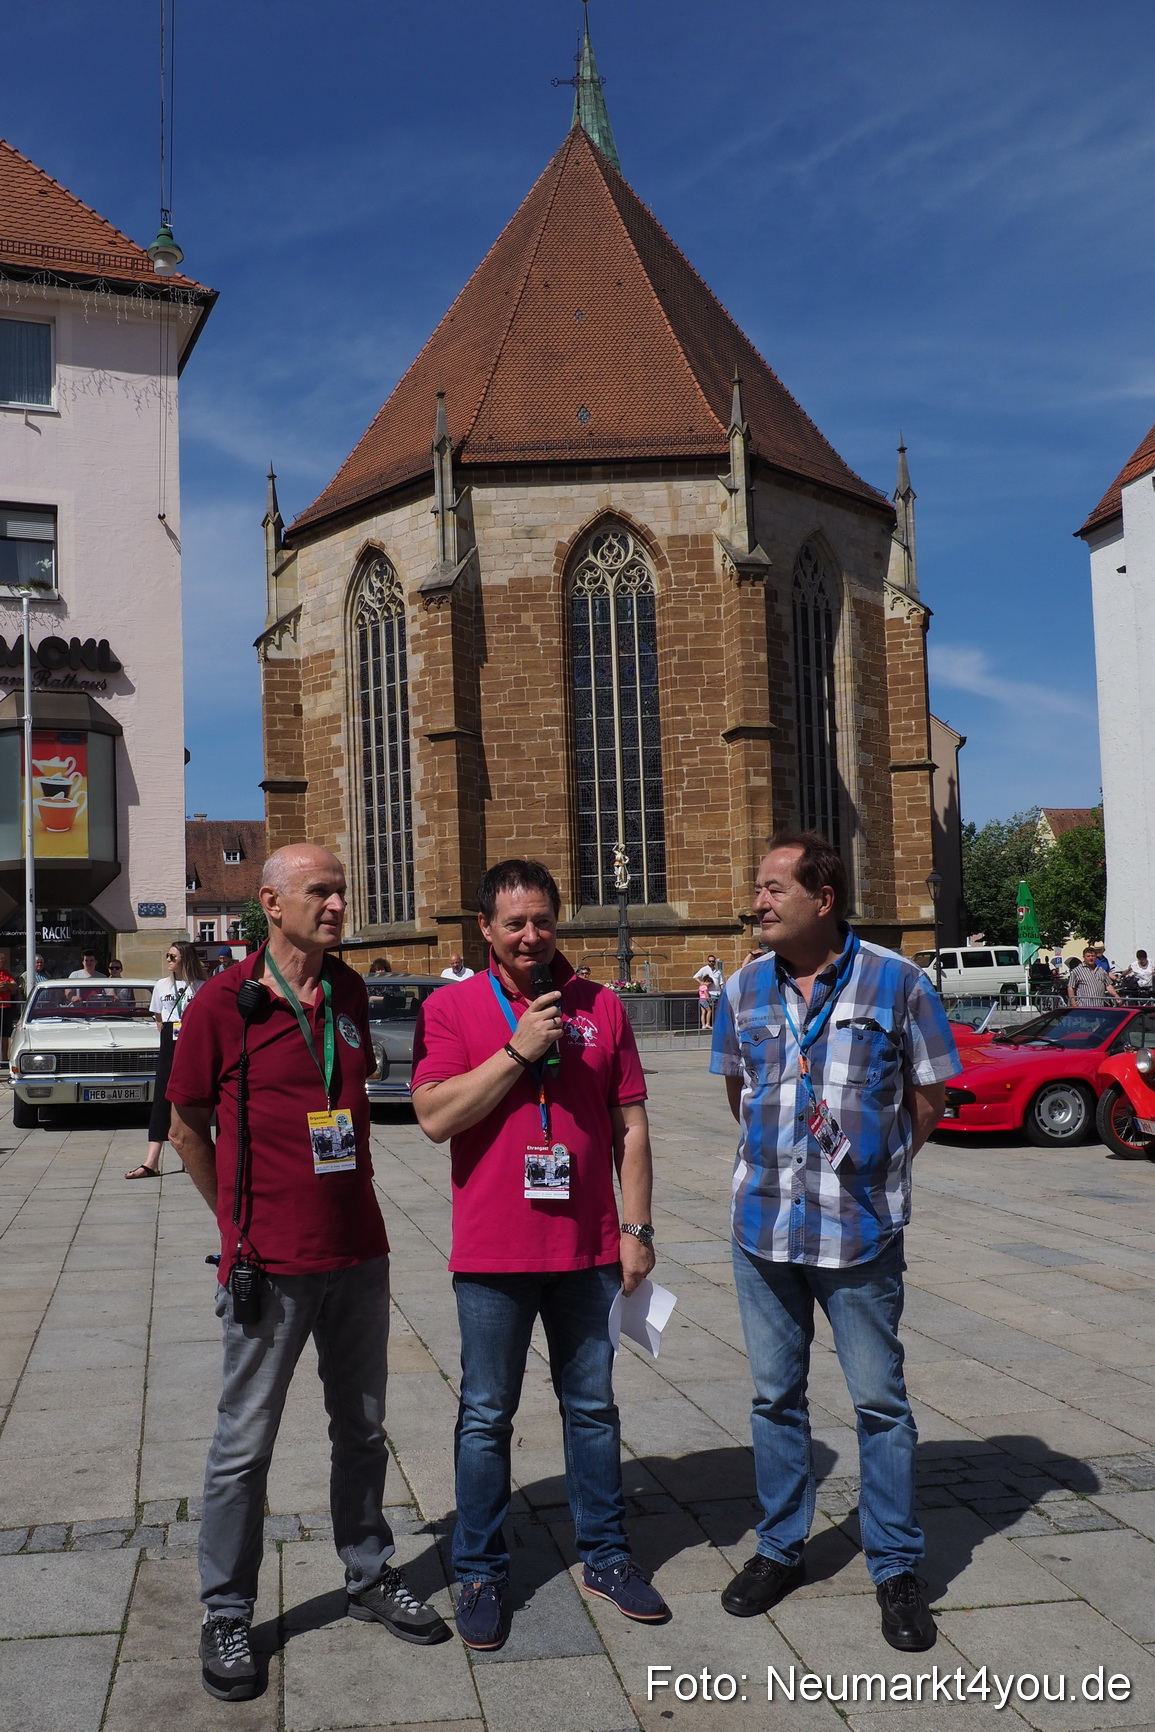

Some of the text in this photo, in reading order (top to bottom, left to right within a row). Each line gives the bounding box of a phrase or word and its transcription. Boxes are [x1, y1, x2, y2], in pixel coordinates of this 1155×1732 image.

[33, 669, 107, 690] Rathaus
[42, 926, 71, 939] RACKL
[89, 1090, 106, 1100] HEB
[112, 1089, 123, 1099] AV
